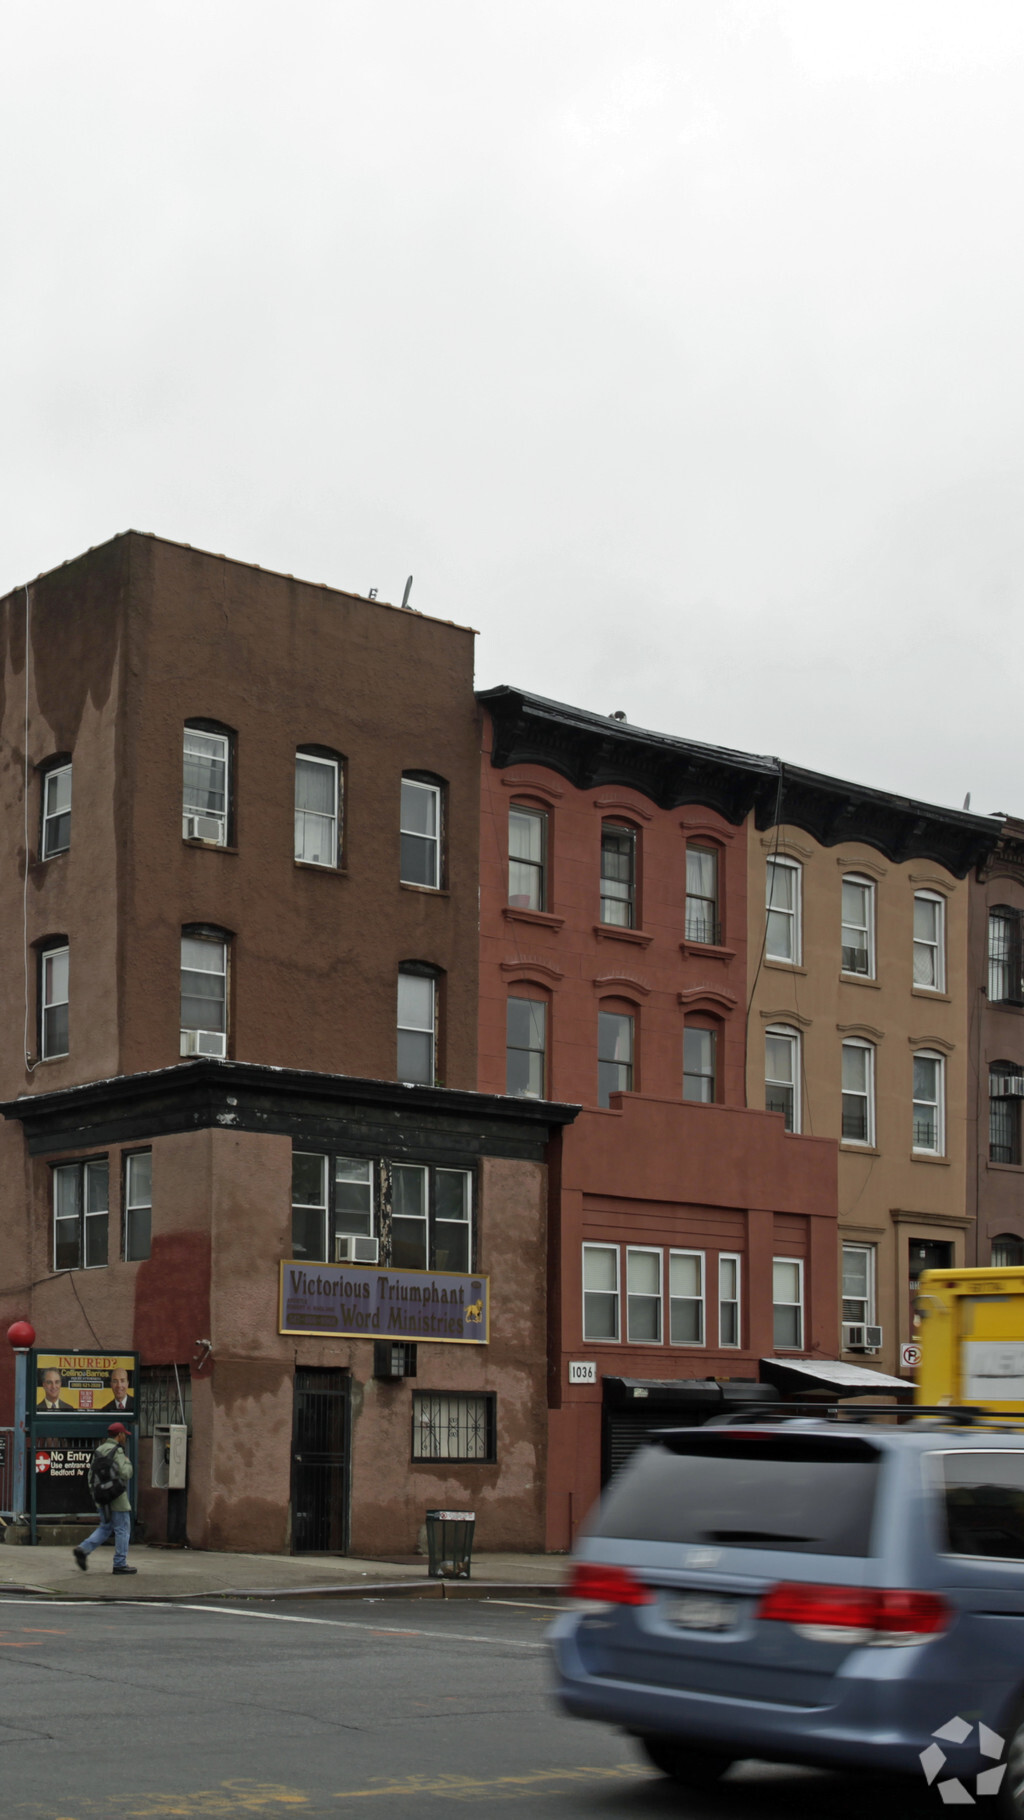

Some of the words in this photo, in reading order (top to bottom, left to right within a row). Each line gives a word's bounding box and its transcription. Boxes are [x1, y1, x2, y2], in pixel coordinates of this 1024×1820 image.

[290, 1270, 370, 1299] Victorious
[377, 1276, 464, 1307] Triumphant
[340, 1303, 381, 1328] Word
[387, 1306, 464, 1334] Ministries
[58, 1357, 118, 1369] INJURED?
[572, 1366, 593, 1378] 1036
[51, 1452, 64, 1461] No
[67, 1452, 91, 1463] Entry
